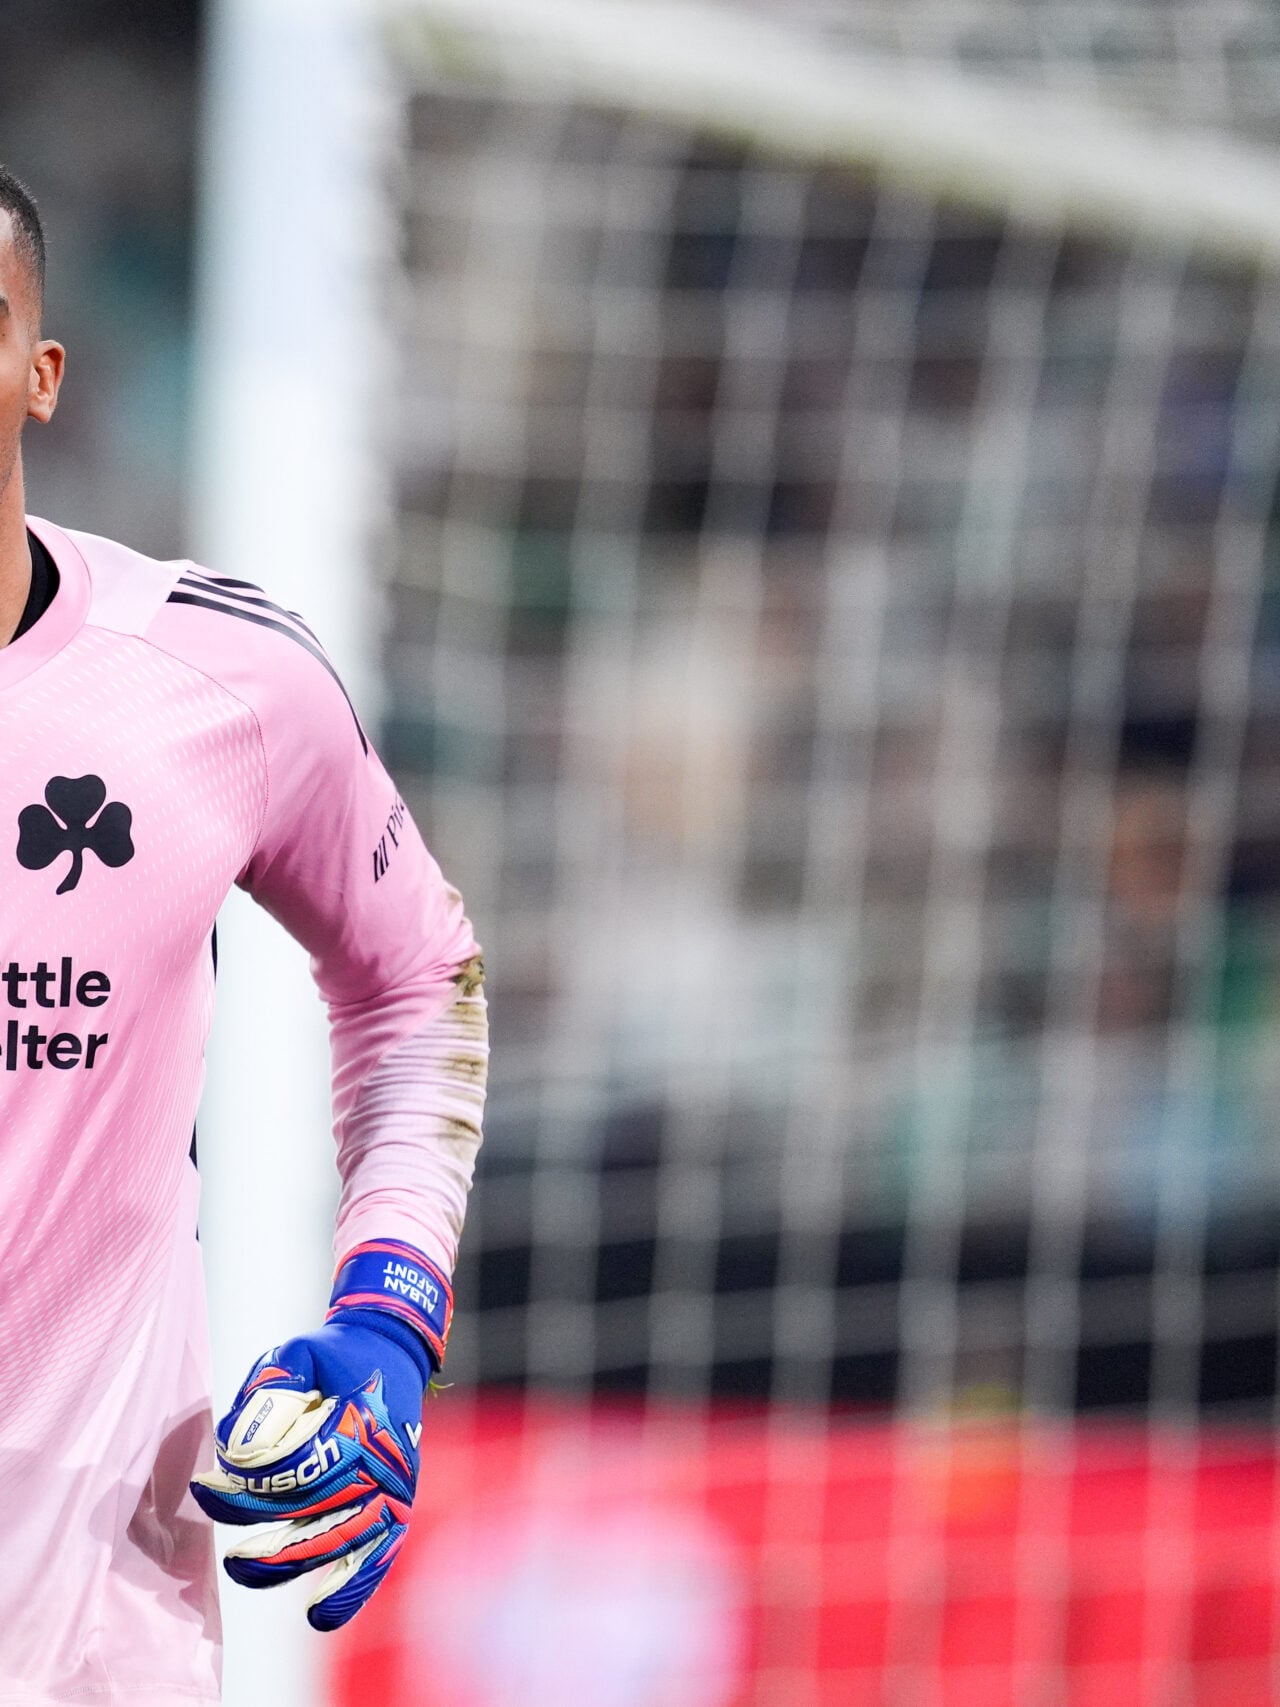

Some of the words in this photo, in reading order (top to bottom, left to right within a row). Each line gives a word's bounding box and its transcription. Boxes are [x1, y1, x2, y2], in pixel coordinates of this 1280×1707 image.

[382, 1261, 439, 1303] LAFONT
[383, 1275, 436, 1314] ALBAN
[223, 1436, 341, 1494] eusch
